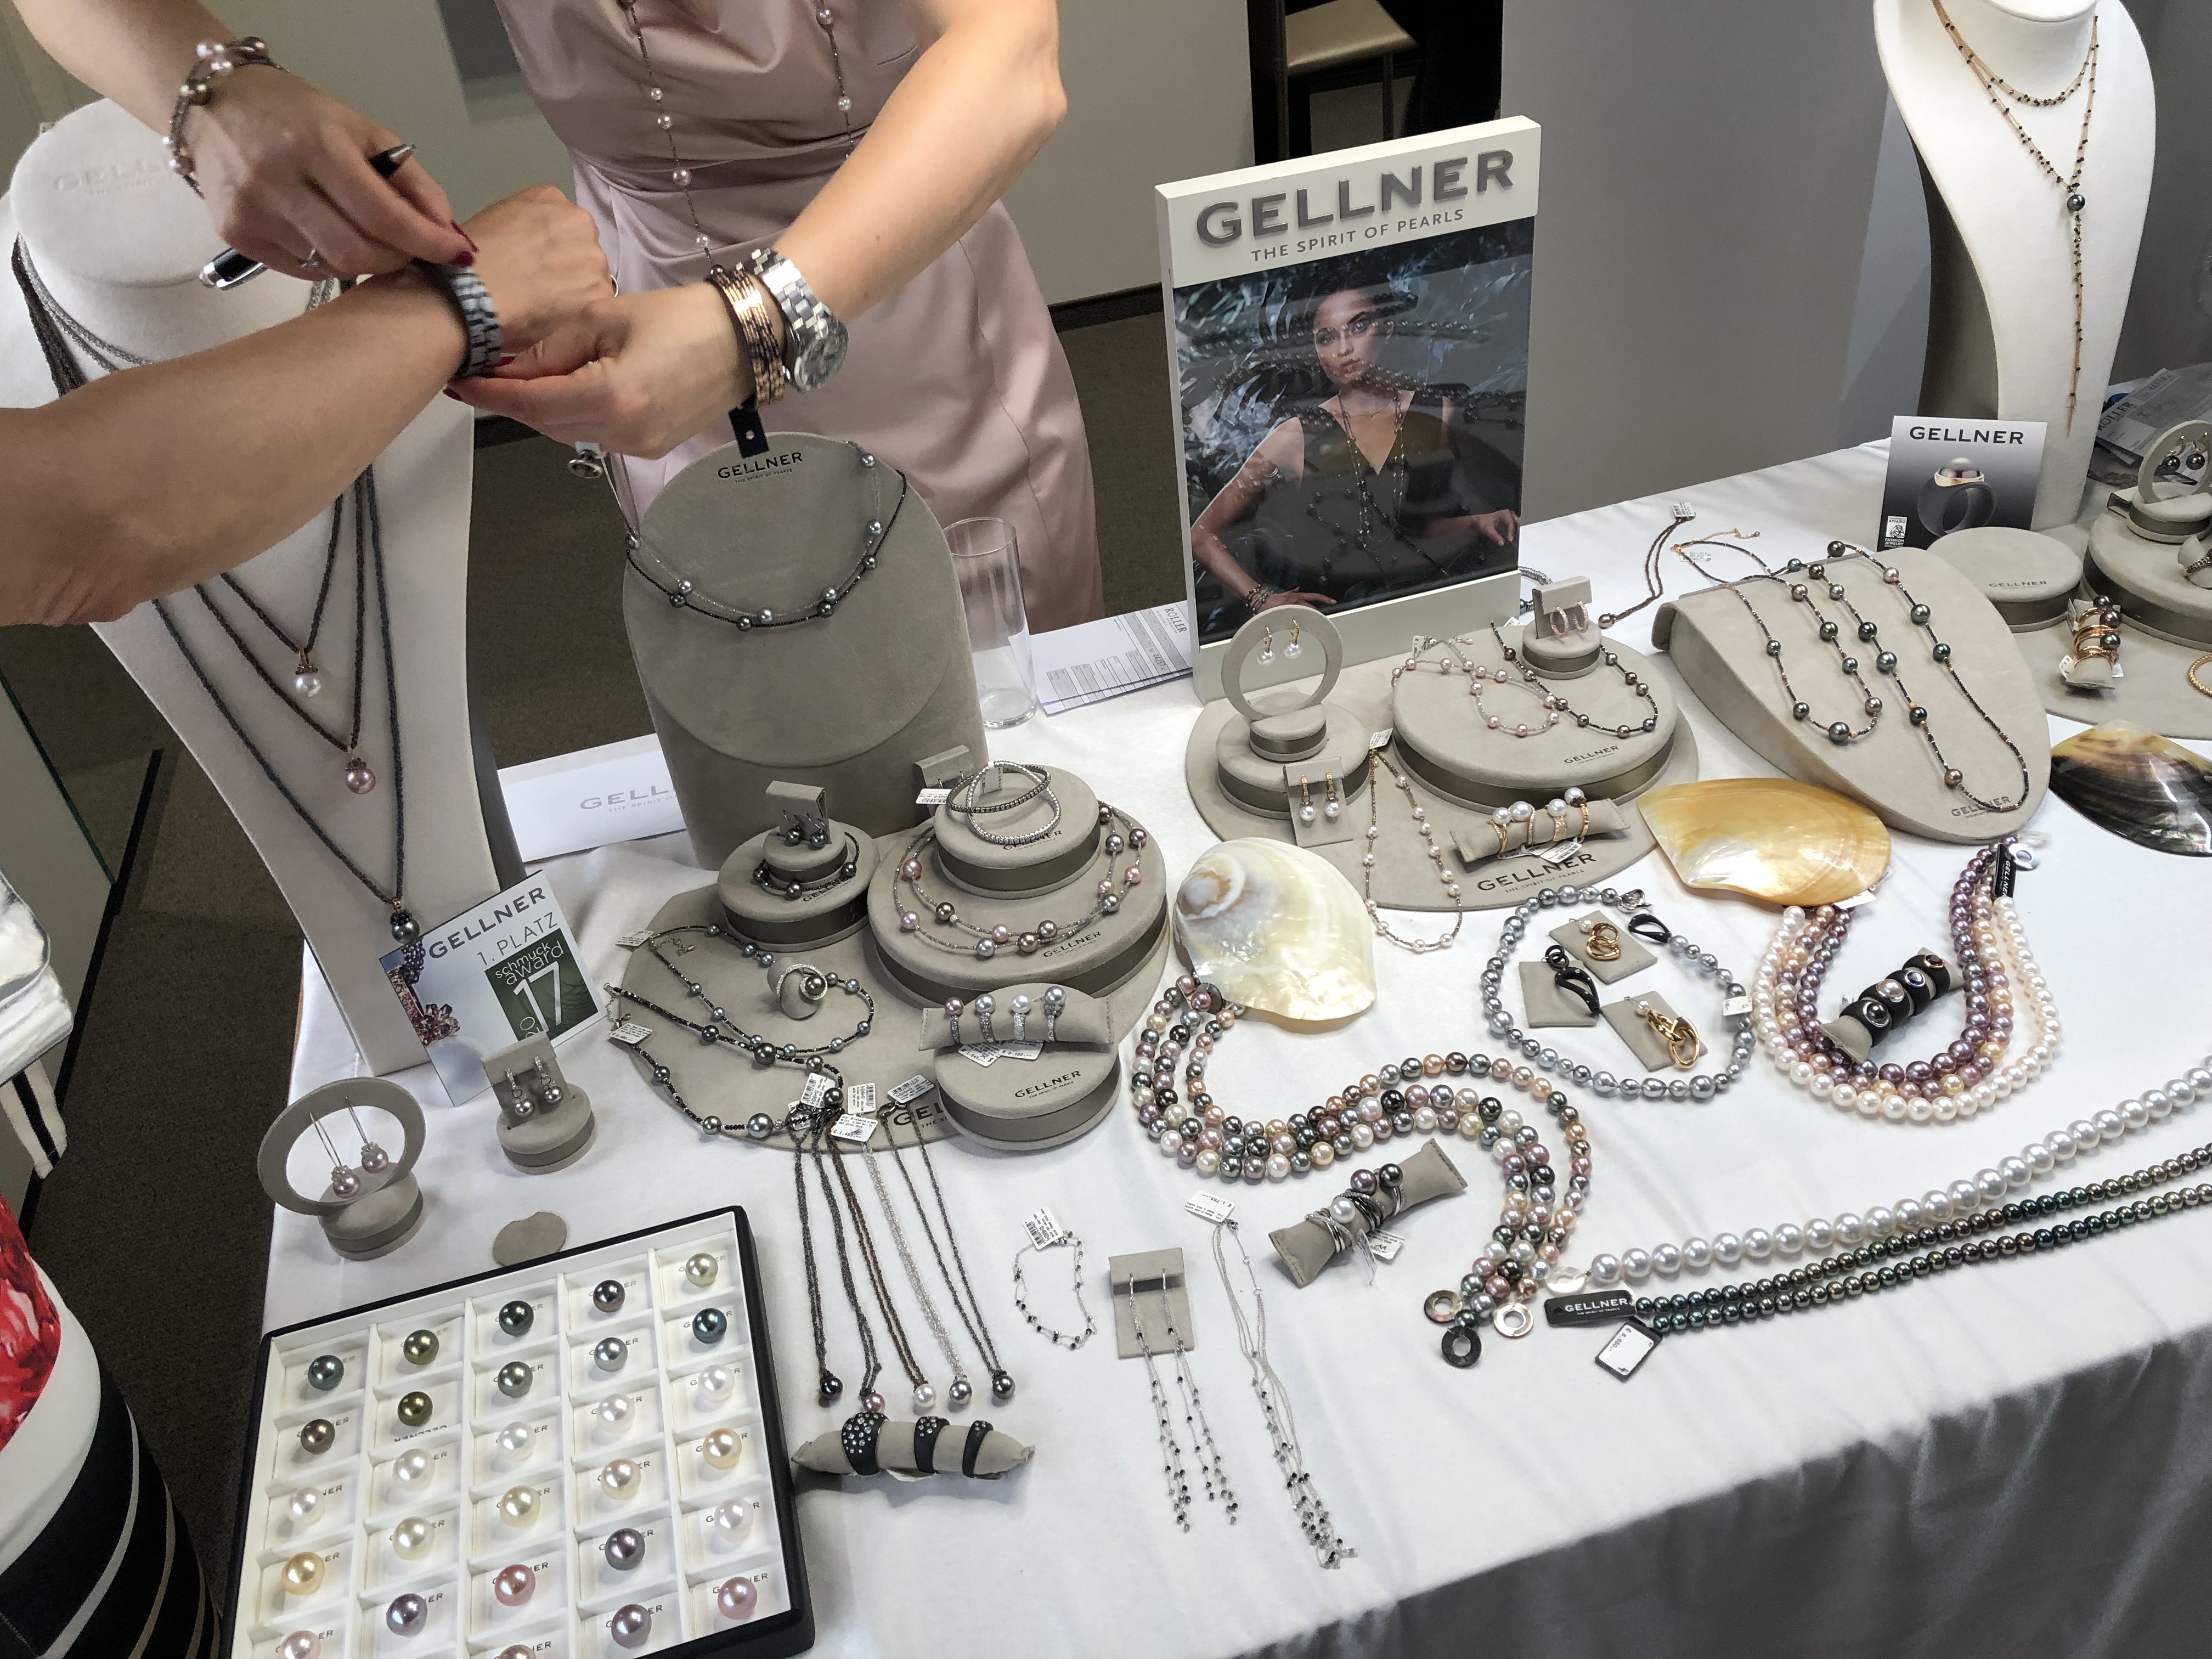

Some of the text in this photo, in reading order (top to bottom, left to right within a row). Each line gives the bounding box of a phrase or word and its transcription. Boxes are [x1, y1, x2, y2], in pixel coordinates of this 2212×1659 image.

[1197, 149, 1514, 244] GELLNER
[1251, 208, 1464, 262] THE SPIRIT OF PEARLS
[1909, 426, 2024, 445] GELLNER
[718, 452, 804, 478] GELLNER
[1164, 607, 1187, 633] ROLLER
[1565, 746, 1620, 764] GELLNER
[580, 786, 669, 809] GELL
[1477, 853, 1596, 891] GELLNER
[1505, 885, 1519, 893] THE
[1522, 879, 1544, 889] SPIRIT
[1559, 869, 1584, 878] PEARLS
[429, 887, 546, 958] GELLNER
[477, 912, 558, 966] 1. PLATZ
[1043, 932, 1102, 957] GELLNER
[495, 942, 551, 979] schmuck
[506, 940, 564, 986] award
[514, 961, 562, 1032] 17
[1015, 1070, 1081, 1097] GELLNER
[1564, 1298, 1629, 1312] GELLNER
